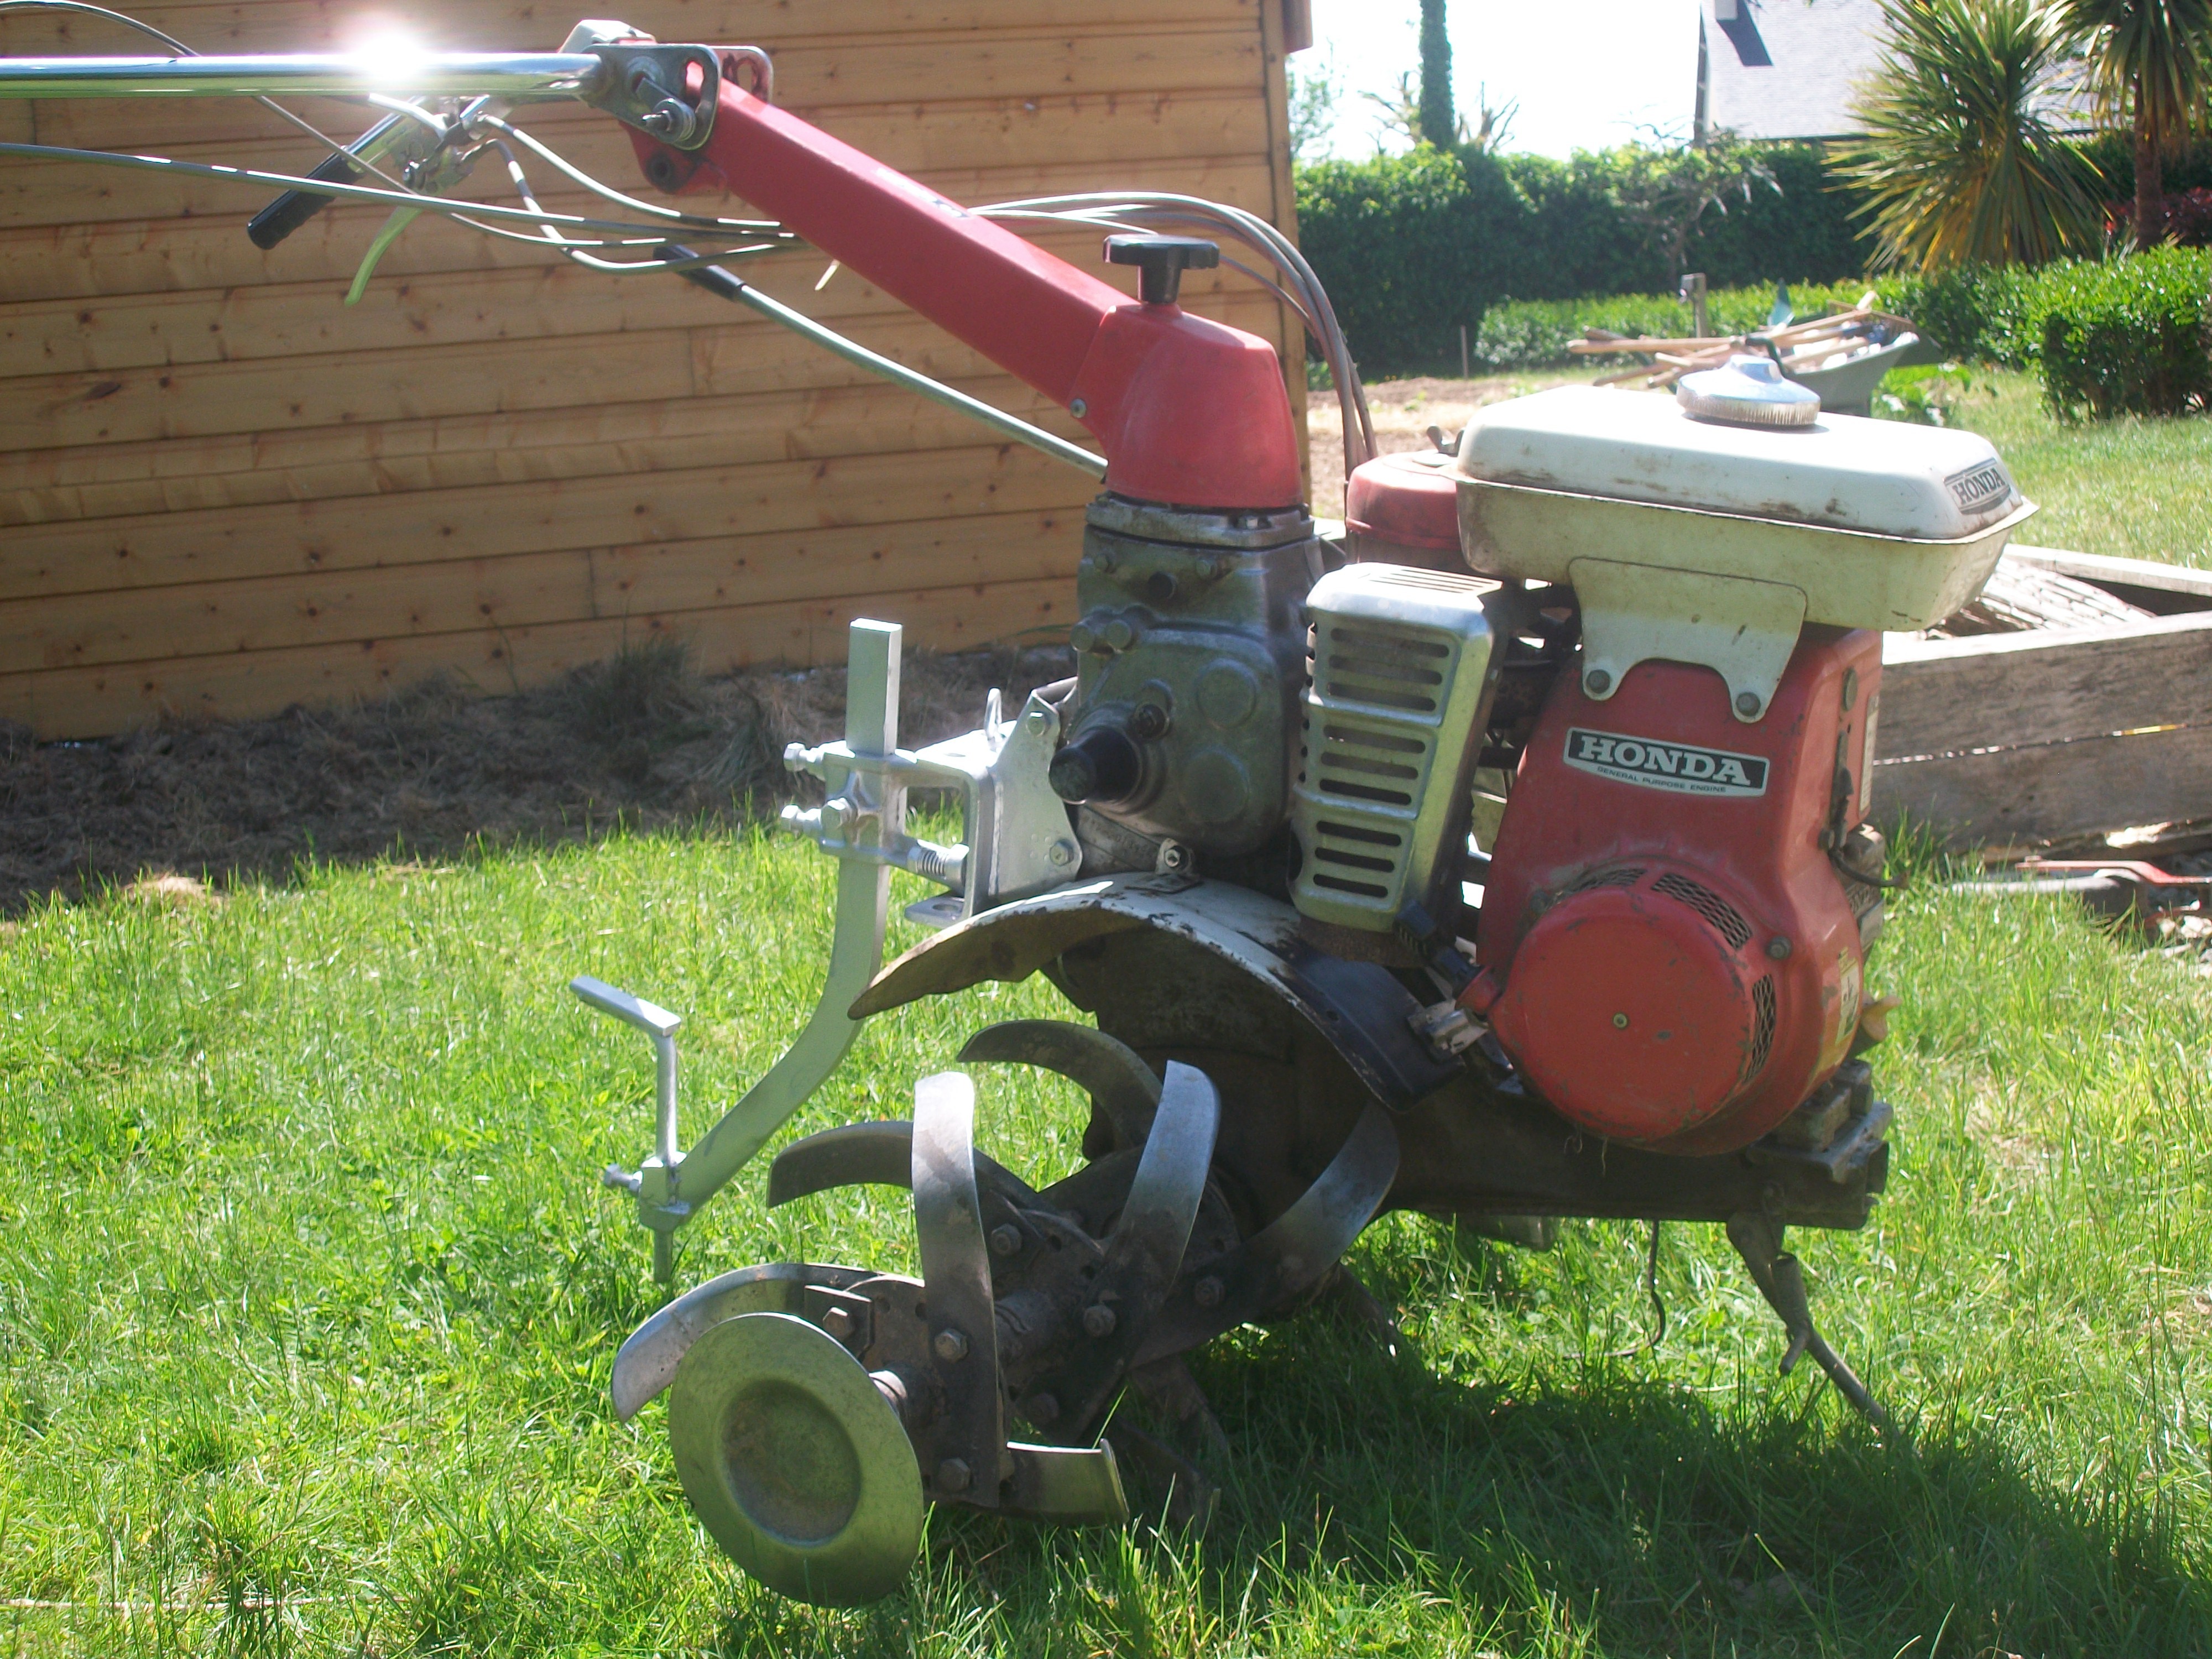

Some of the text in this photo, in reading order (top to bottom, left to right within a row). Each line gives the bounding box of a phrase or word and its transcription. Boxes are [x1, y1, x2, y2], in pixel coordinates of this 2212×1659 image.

[1952, 468, 2006, 505] HONDA
[1578, 735, 1751, 786] HONDA
[1597, 766, 1726, 793] GENERAL PURPOSE ENGINE
